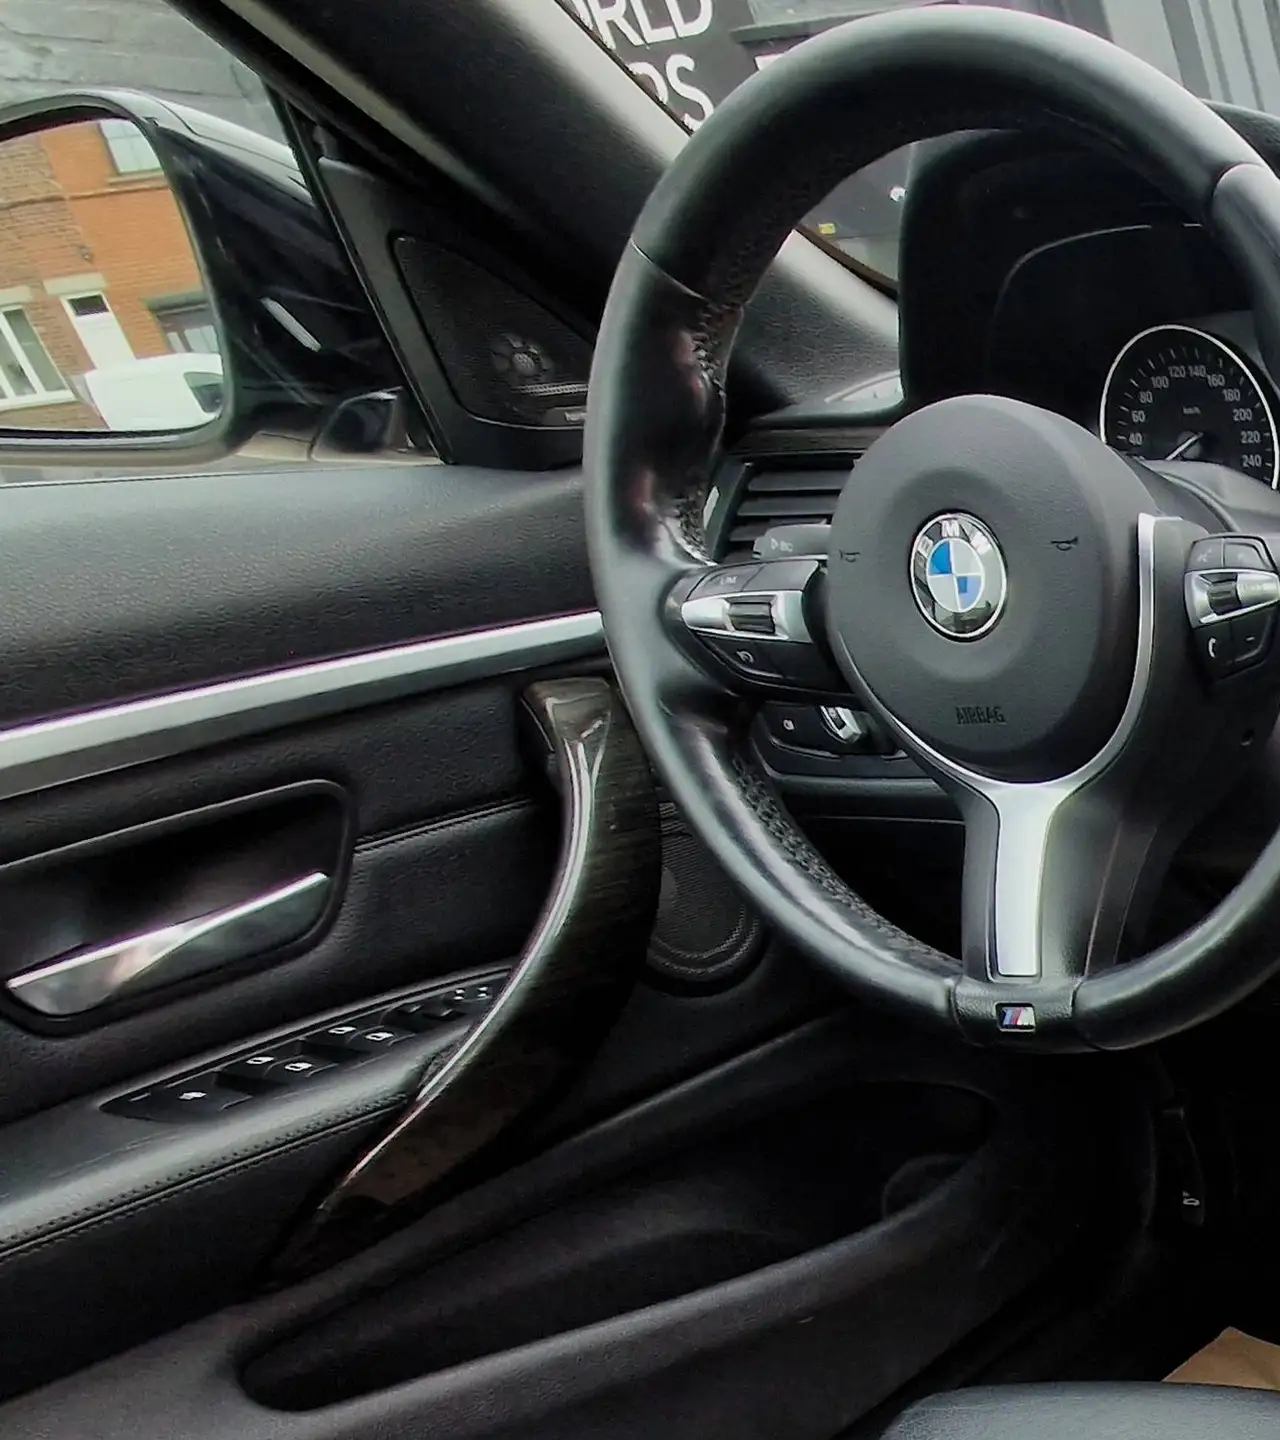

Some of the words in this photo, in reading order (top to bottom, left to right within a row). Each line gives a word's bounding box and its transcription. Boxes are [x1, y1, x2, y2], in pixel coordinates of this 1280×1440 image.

[1168, 365, 1187, 378] 120
[1188, 365, 1207, 377] 140
[1151, 375, 1170, 389] 100
[1207, 374, 1225, 388] 160
[1139, 391, 1153, 404] 80
[1222, 388, 1241, 401] 180
[1131, 410, 1146, 423] 60
[1232, 408, 1253, 421] 200
[1128, 433, 1143, 445] 40
[1240, 430, 1261, 444] 220
[1242, 454, 1262, 468] 240
